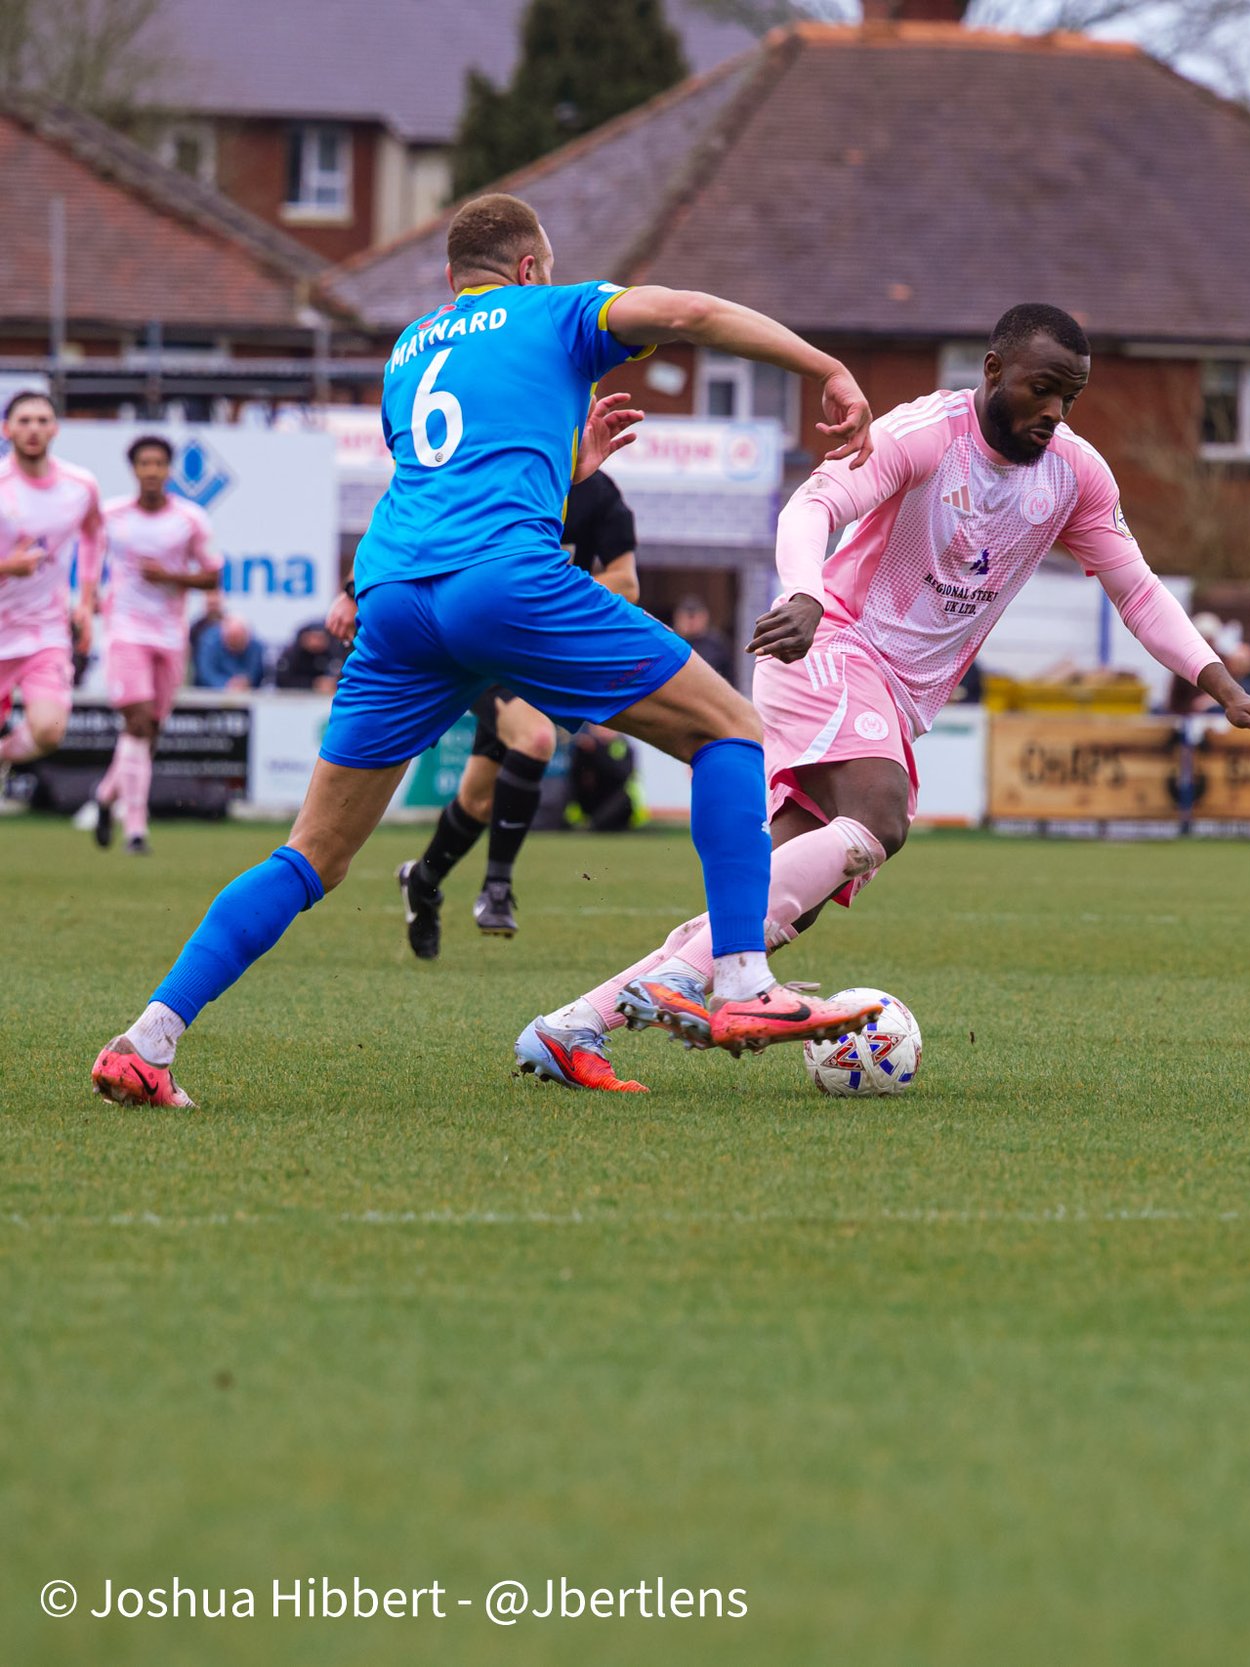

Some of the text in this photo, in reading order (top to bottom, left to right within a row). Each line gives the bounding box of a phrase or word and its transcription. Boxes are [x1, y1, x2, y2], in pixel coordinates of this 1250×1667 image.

[389, 307, 508, 375] MAYNARD
[411, 347, 464, 468] 6
[924, 572, 970, 600] REGIONAL
[944, 600, 976, 615] UK LTD.
